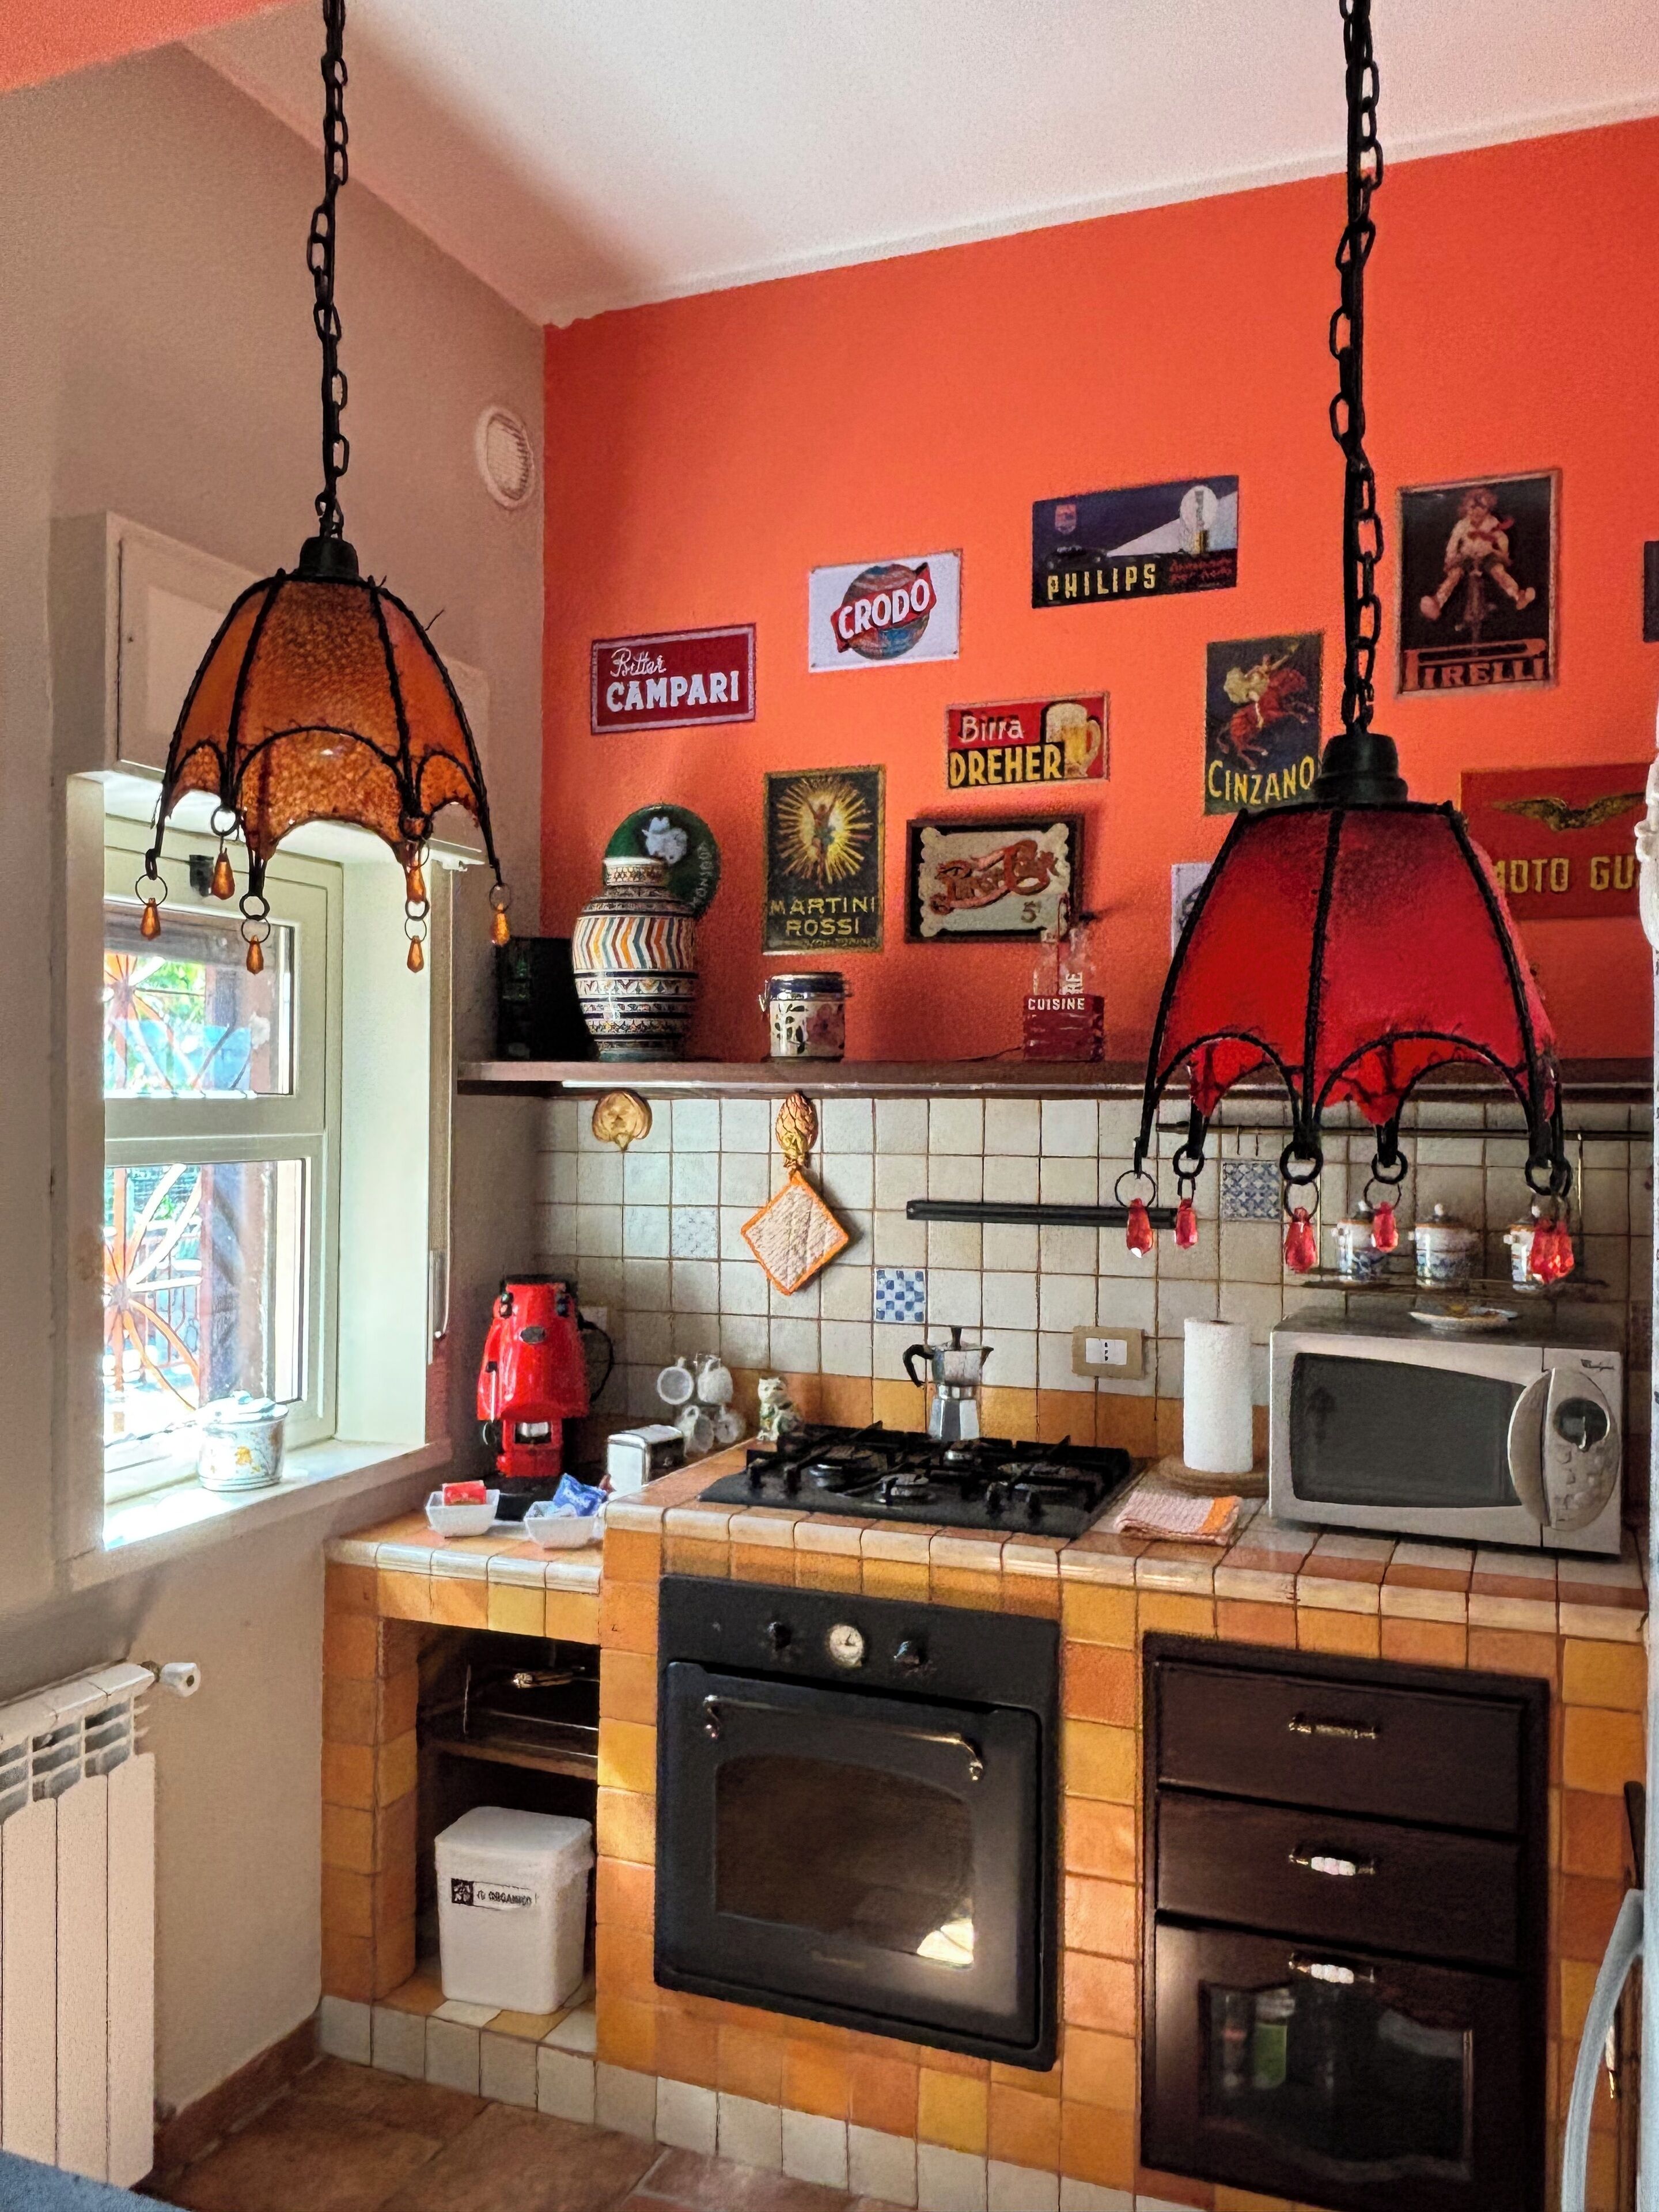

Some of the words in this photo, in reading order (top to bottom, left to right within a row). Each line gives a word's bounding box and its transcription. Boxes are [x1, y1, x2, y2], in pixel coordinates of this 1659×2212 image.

[1047, 563, 1156, 601] PHILIPS
[838, 578, 930, 639] CRODO
[609, 647, 667, 678] Bitter
[1402, 638, 1547, 691] PIRELLI
[606, 670, 740, 713] CAMPARI
[958, 714, 1025, 743] Birra
[949, 743, 1063, 787] DREHER
[1208, 755, 1315, 805] CINZANO
[1590, 854, 1636, 891] GU
[769, 896, 875, 915] MARTINI
[785, 916, 860, 937] ROSSI
[1028, 997, 1086, 1010] CUISINE
